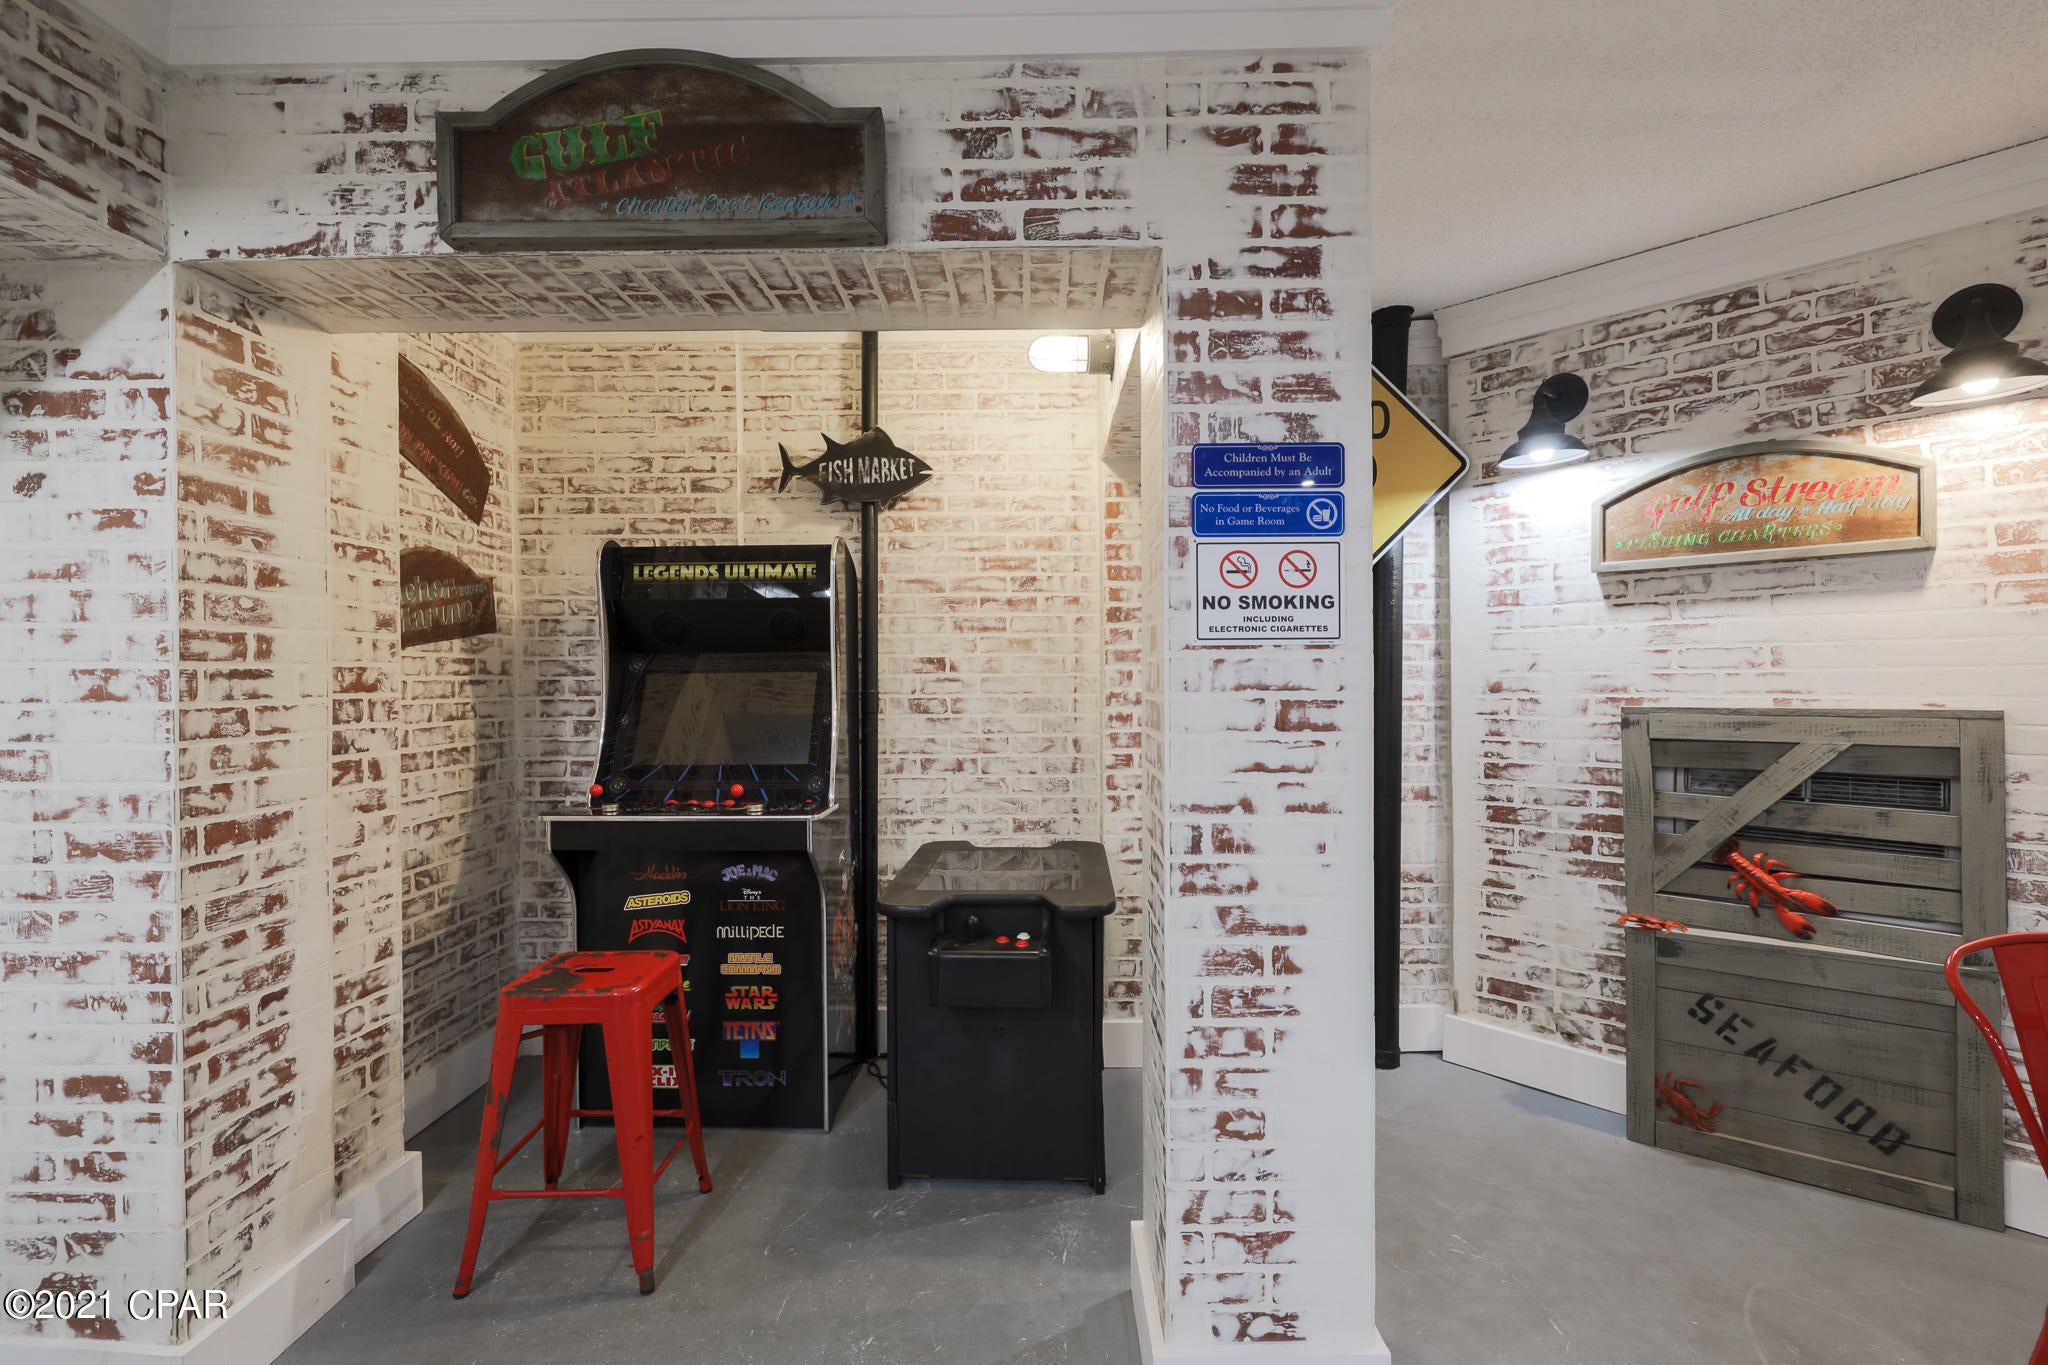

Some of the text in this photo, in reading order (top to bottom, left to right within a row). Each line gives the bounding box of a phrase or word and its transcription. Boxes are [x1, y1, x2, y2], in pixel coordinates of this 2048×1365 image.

[509, 108, 664, 181] GULF
[546, 135, 752, 208] ATLANTIC
[615, 192, 841, 216] Charter Boat Rentals
[1223, 453, 1312, 463] Children Must Be
[818, 456, 916, 485] FISH MARKET
[1204, 467, 1272, 477] Accompanied
[1274, 466, 1286, 478] by
[1304, 466, 1332, 476] Adult
[1200, 503, 1215, 513] No
[1217, 503, 1239, 513] Food
[1255, 503, 1300, 514] Beverages
[1645, 473, 1901, 530] Gulf Stream
[1721, 494, 1912, 523] All day Half day
[1215, 516, 1285, 526] in Game Room
[633, 562, 817, 581] LEGENDS ULTIMATE
[1202, 595, 1335, 610] NO SMOKING
[1243, 615, 1294, 623] INCLUDING
[1208, 625, 1329, 633] ELECTRONIC CIGARETTES
[630, 863, 689, 881] Aladdin
[721, 863, 746, 882] JOE
[752, 863, 779, 882] MAC
[625, 891, 690, 909] ASTEROIDS
[719, 899, 786, 912] LION KING
[628, 919, 687, 944] ASTYANAX
[727, 953, 774, 964] MISSILE
[720, 964, 782, 975] COMMAND
[725, 985, 778, 997] STAR
[725, 997, 778, 1010] WARS
[723, 1021, 777, 1041] TETRIS
[718, 1069, 787, 1087] TRON
[1687, 992, 1912, 1156] SEAFOOD
